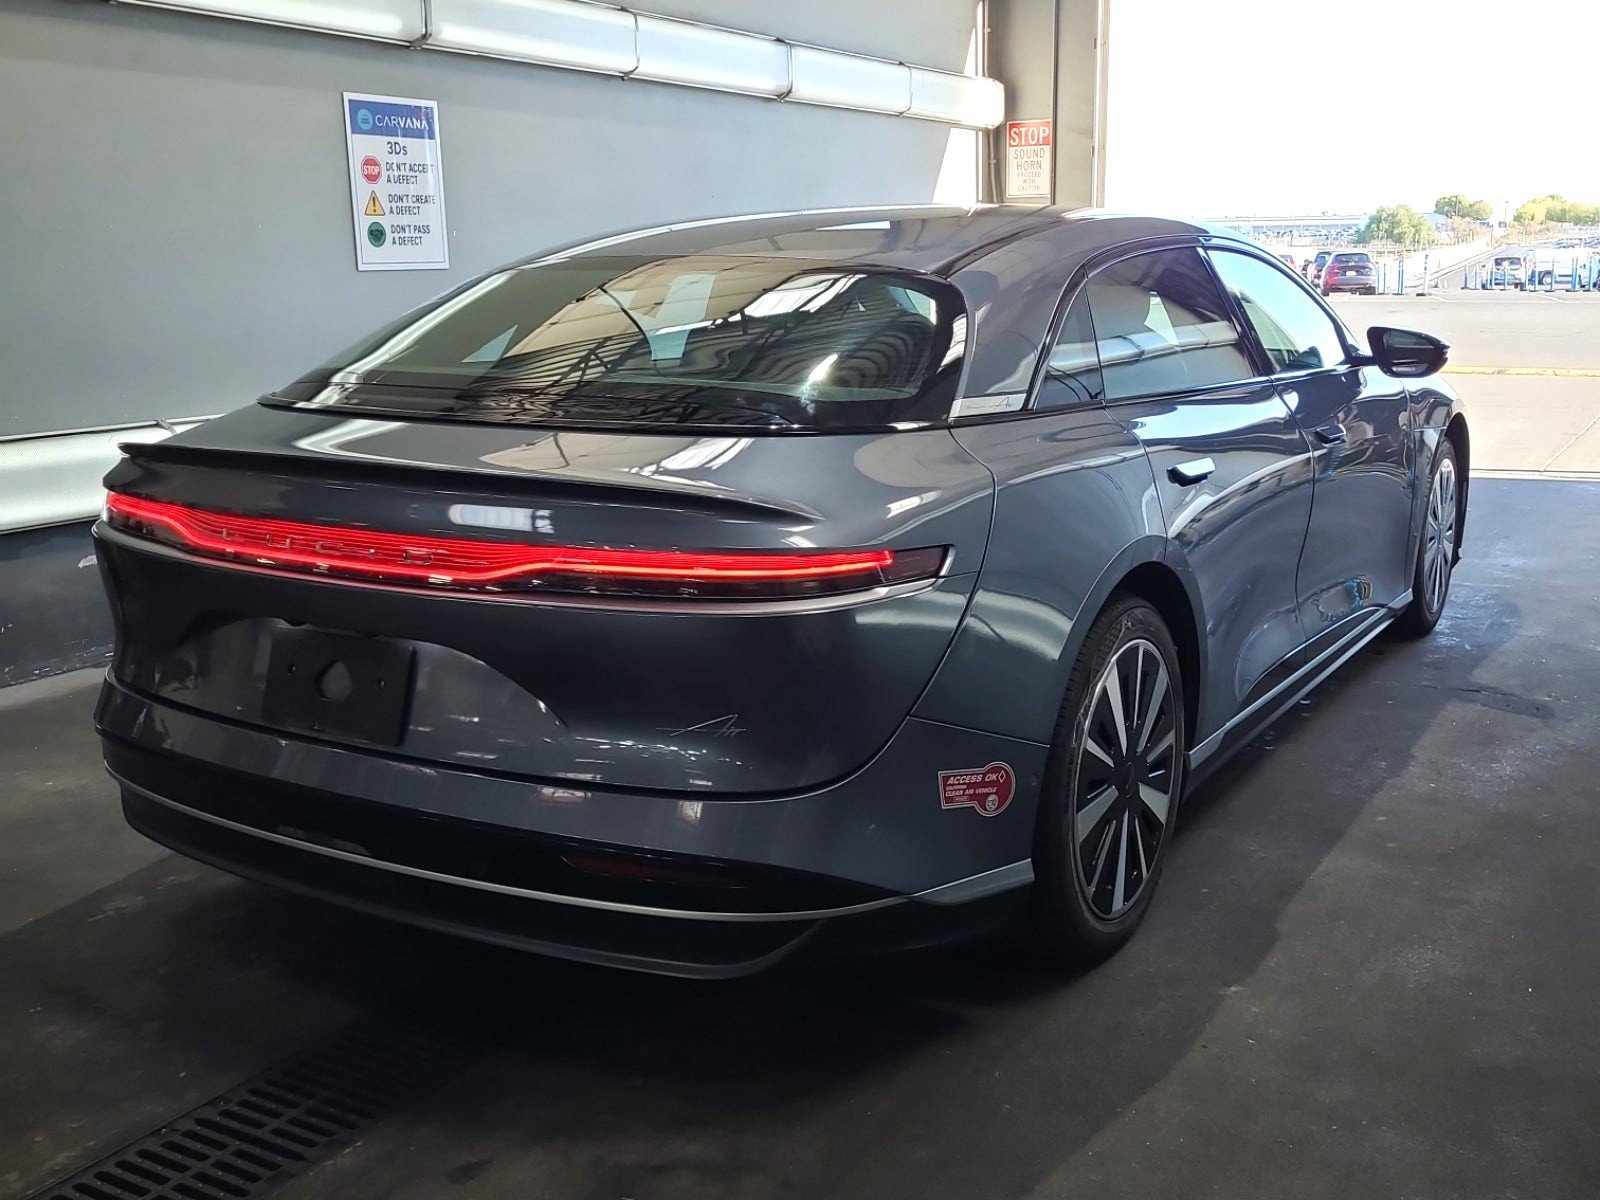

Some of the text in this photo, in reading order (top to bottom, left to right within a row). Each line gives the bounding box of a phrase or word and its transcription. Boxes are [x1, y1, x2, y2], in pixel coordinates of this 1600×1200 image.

[375, 115, 429, 130] CARVANA
[1010, 126, 1049, 146] STOP
[386, 141, 408, 156] 3Ds
[1014, 147, 1045, 160] SOUND
[363, 165, 380, 176] STOP
[385, 161, 407, 173] DON'T
[1016, 160, 1042, 171] HORN
[386, 174, 392, 184] A
[388, 193, 436, 205] DON'T CREATE
[389, 205, 420, 216] A DEFECT
[390, 224, 431, 235] DON'T PASS
[392, 236, 422, 246] A DEFECT
[946, 772, 999, 785] ACCESS OK
[945, 789, 964, 797] CLEAN
[975, 786, 998, 794] VEHICLE
